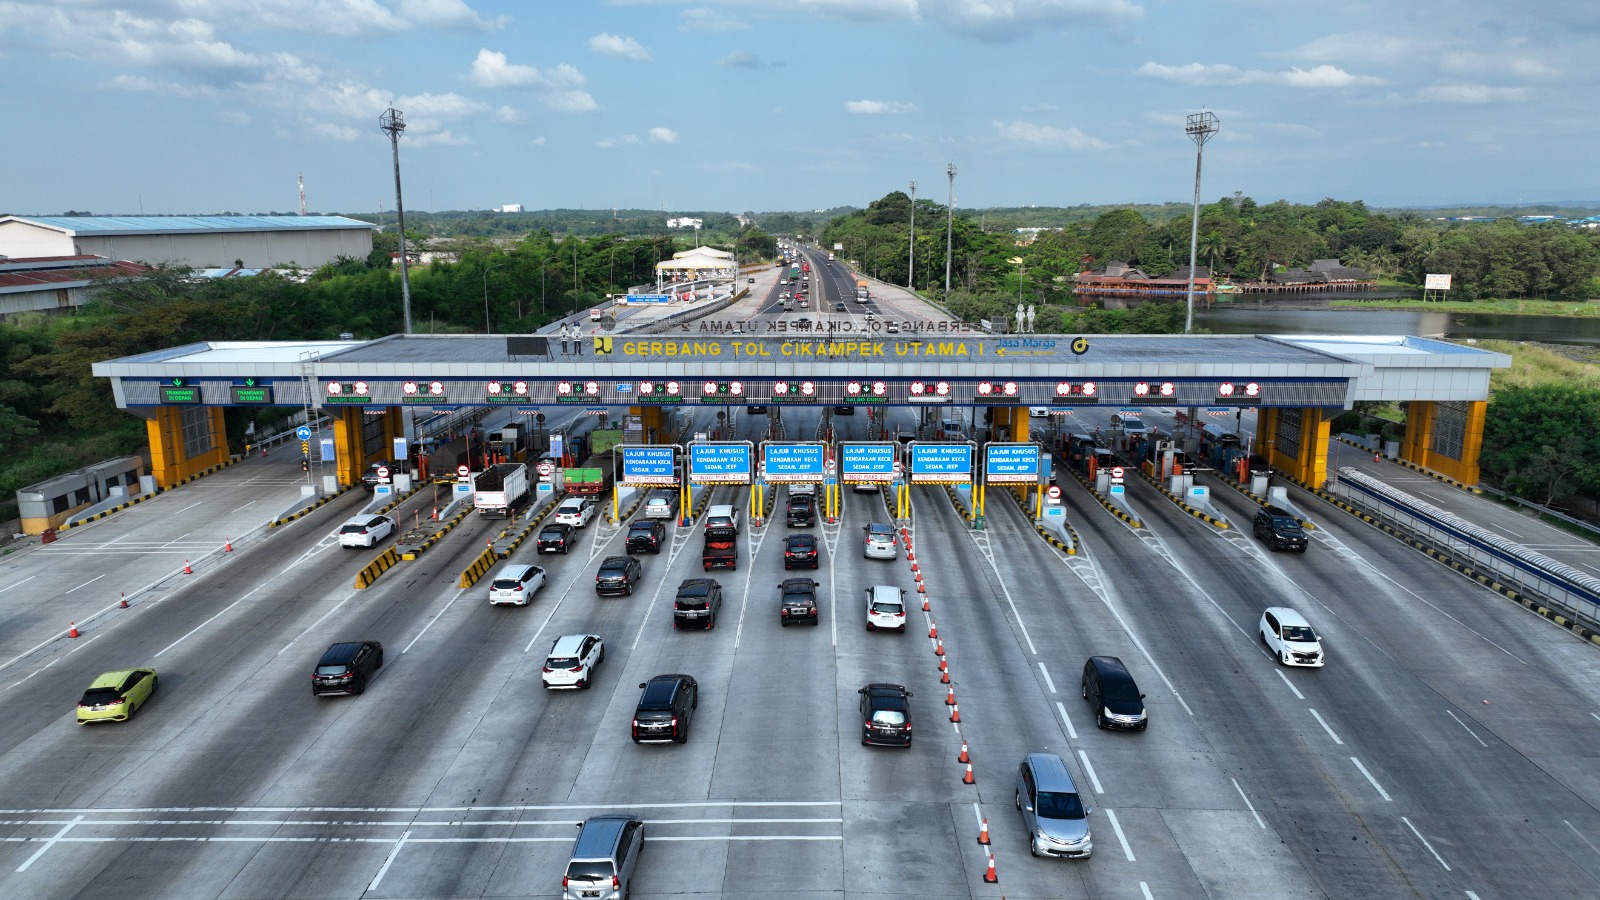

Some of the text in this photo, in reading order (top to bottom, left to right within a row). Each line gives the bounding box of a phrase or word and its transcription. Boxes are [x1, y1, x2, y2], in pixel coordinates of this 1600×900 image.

[623, 342, 721, 355] GERBANG
[731, 342, 770, 355] TOL
[781, 342, 885, 355] CIKAMPEK
[895, 342, 968, 355] UTAMA
[998, 338, 1056, 349] Jasa Marga
